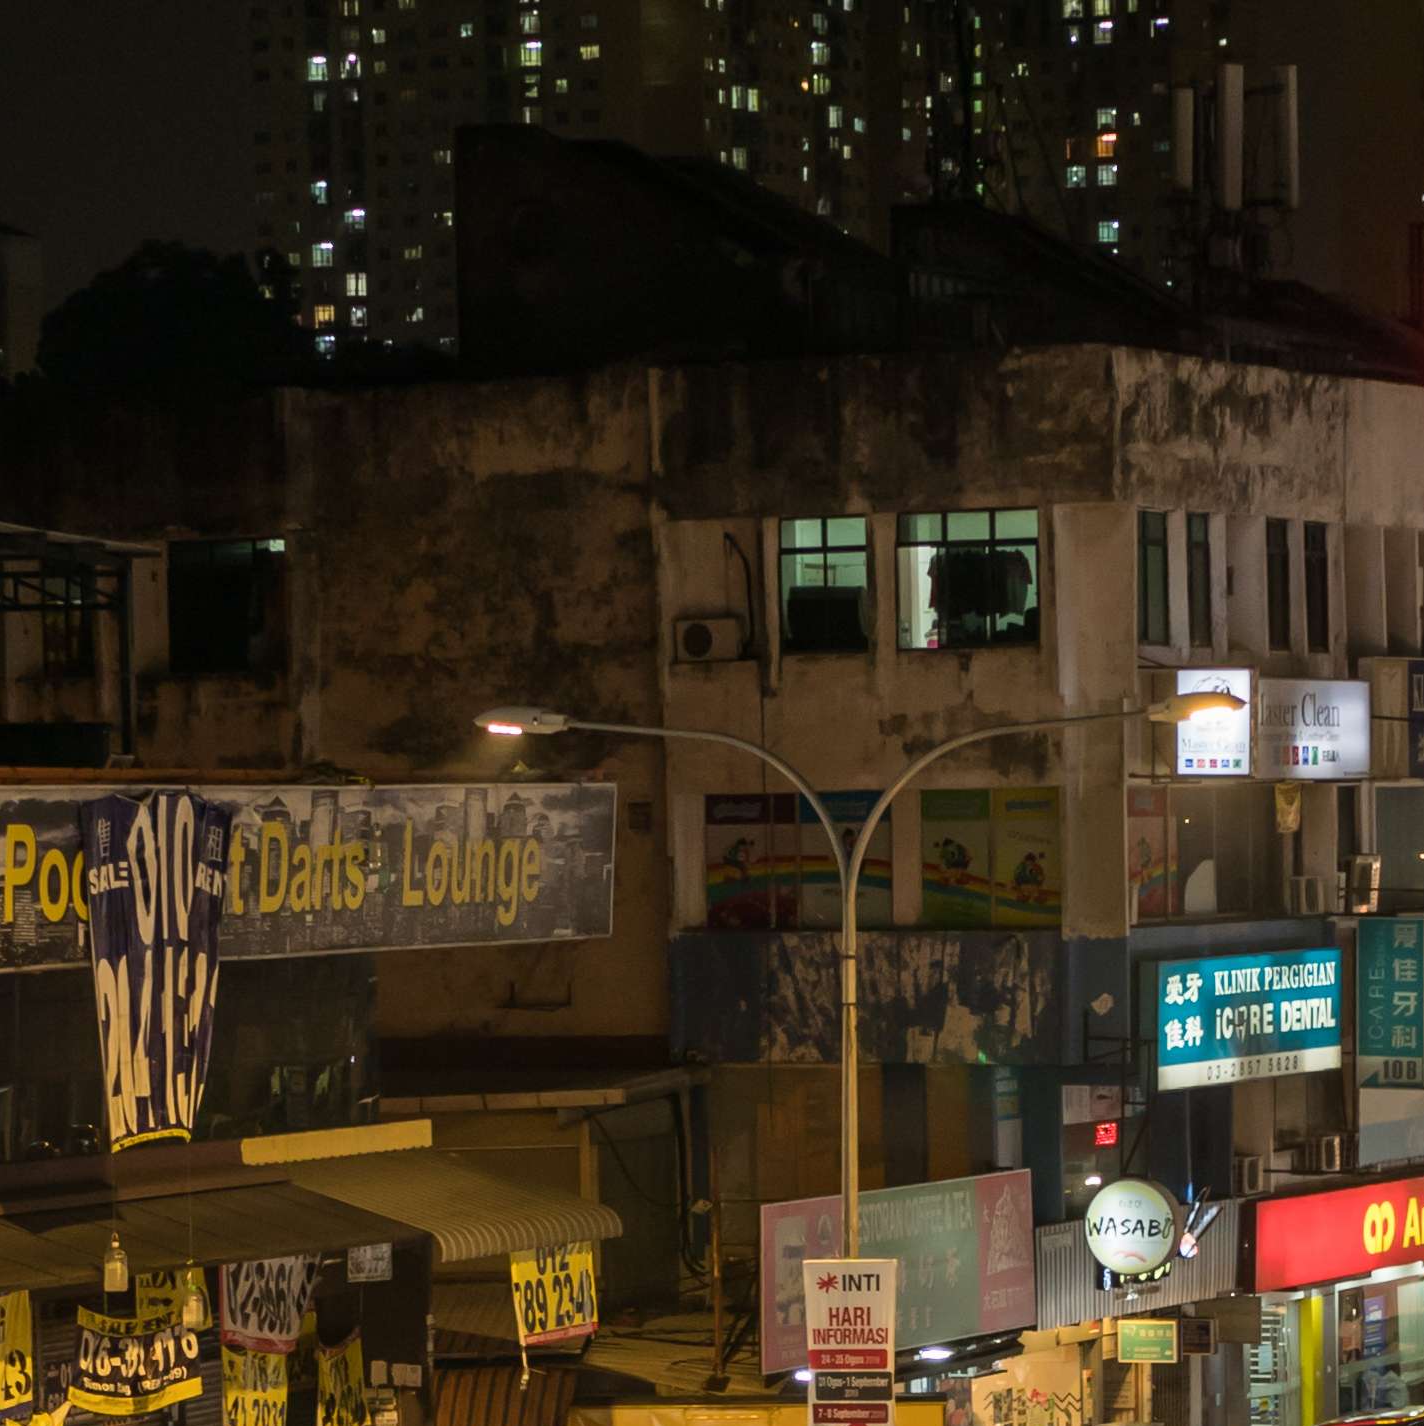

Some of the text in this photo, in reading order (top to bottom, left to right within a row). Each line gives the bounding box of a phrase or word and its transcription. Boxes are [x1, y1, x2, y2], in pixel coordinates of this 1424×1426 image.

[1302, 692, 1340, 727] Clean
[88, 861, 129, 896] SALE
[258, 819, 368, 914] Darts
[400, 816, 541, 927] Lounge
[1214, 961, 1336, 996] KLINIK PERGIGIAN
[1280, 997, 1335, 1033] DENTAL
[842, 1273, 880, 1292] INTI
[828, 1306, 871, 1327] HARI
[813, 1327, 888, 1345] INFORMASI
